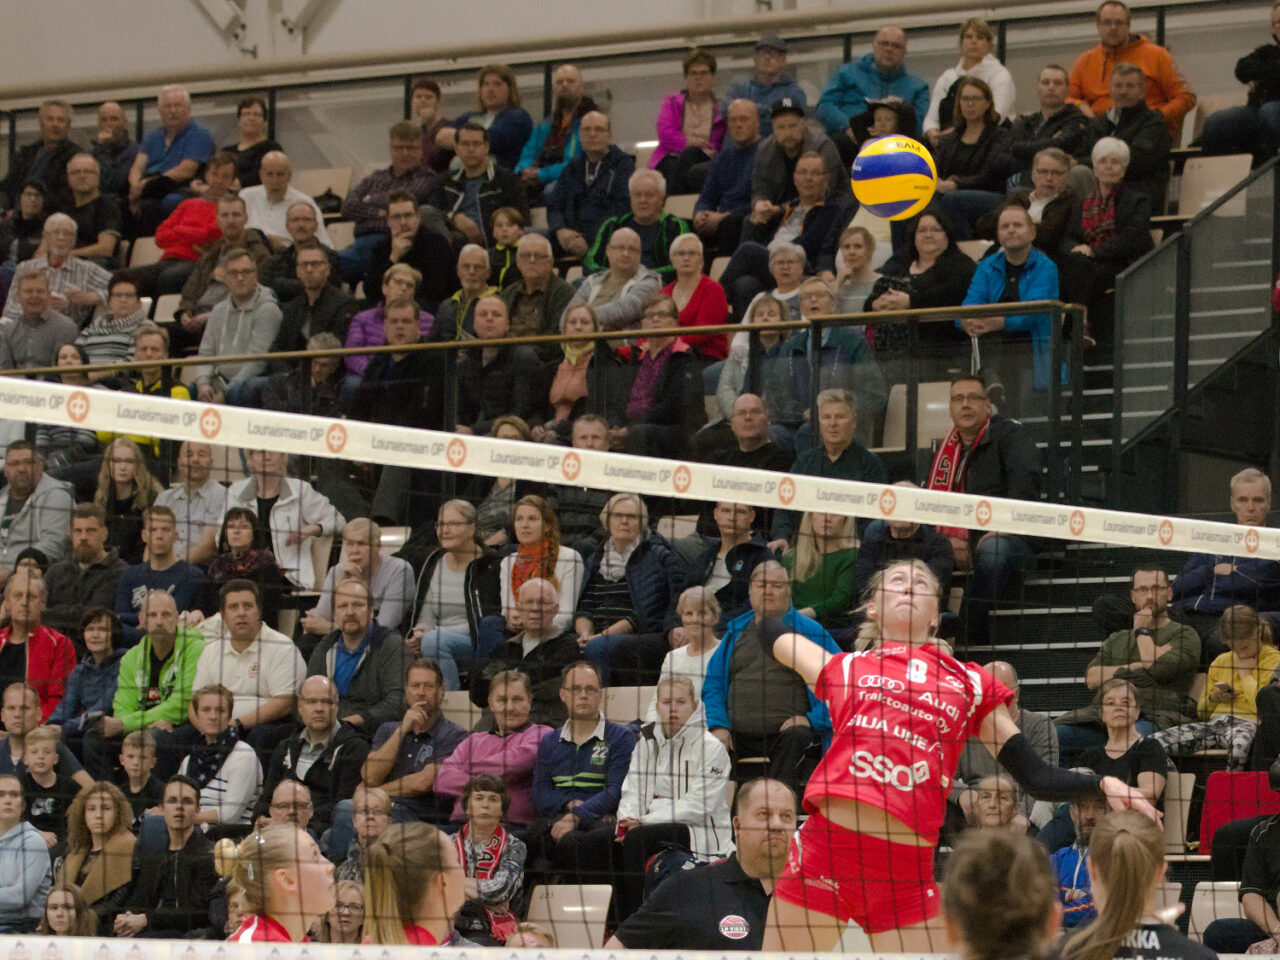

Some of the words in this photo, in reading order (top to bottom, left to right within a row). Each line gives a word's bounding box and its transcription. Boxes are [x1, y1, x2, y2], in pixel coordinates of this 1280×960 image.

[905, 658, 928, 684] 8
[858, 691, 934, 721] Traktoauto
[935, 717, 950, 734] Oy
[919, 692, 961, 722] Audi
[893, 725, 929, 750] LINE
